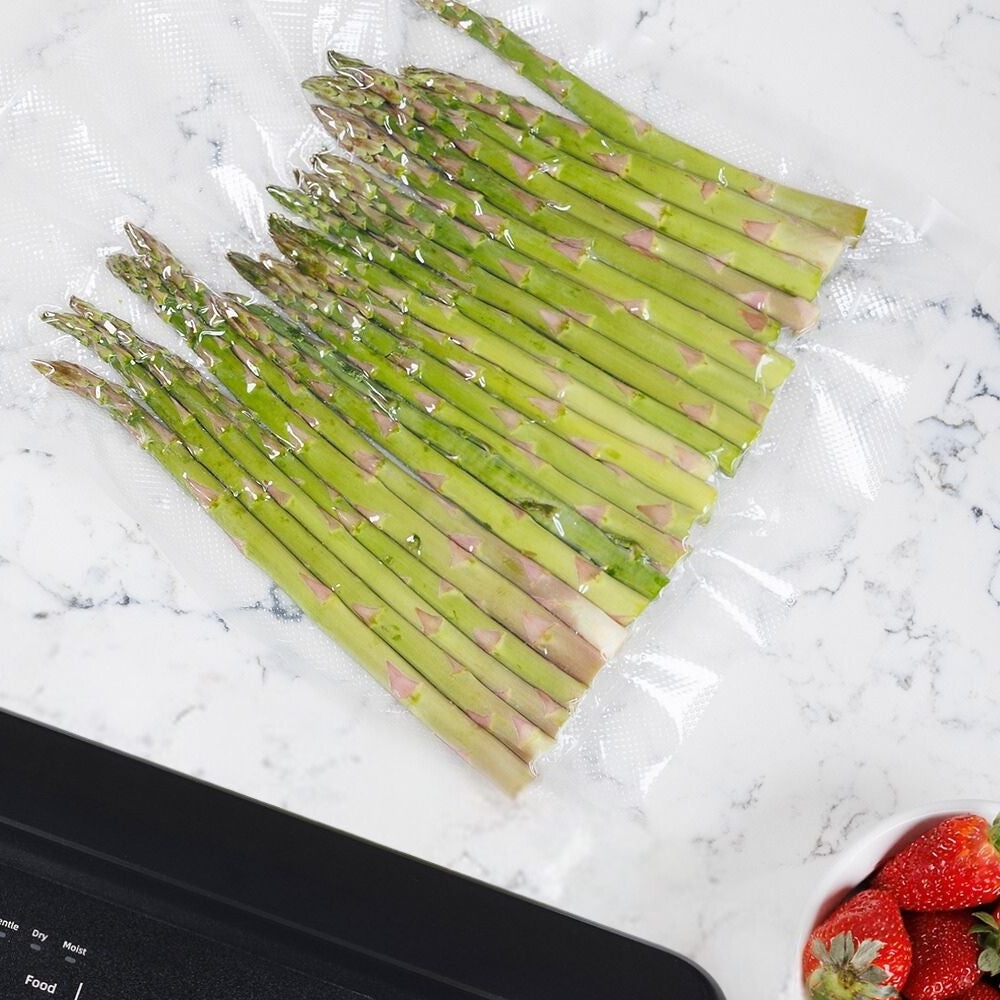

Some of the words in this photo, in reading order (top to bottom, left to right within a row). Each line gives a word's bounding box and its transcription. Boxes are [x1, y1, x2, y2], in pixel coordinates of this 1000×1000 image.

[31, 928, 49, 942] Dry
[62, 940, 88, 957] Moist
[24, 974, 58, 995] Food
